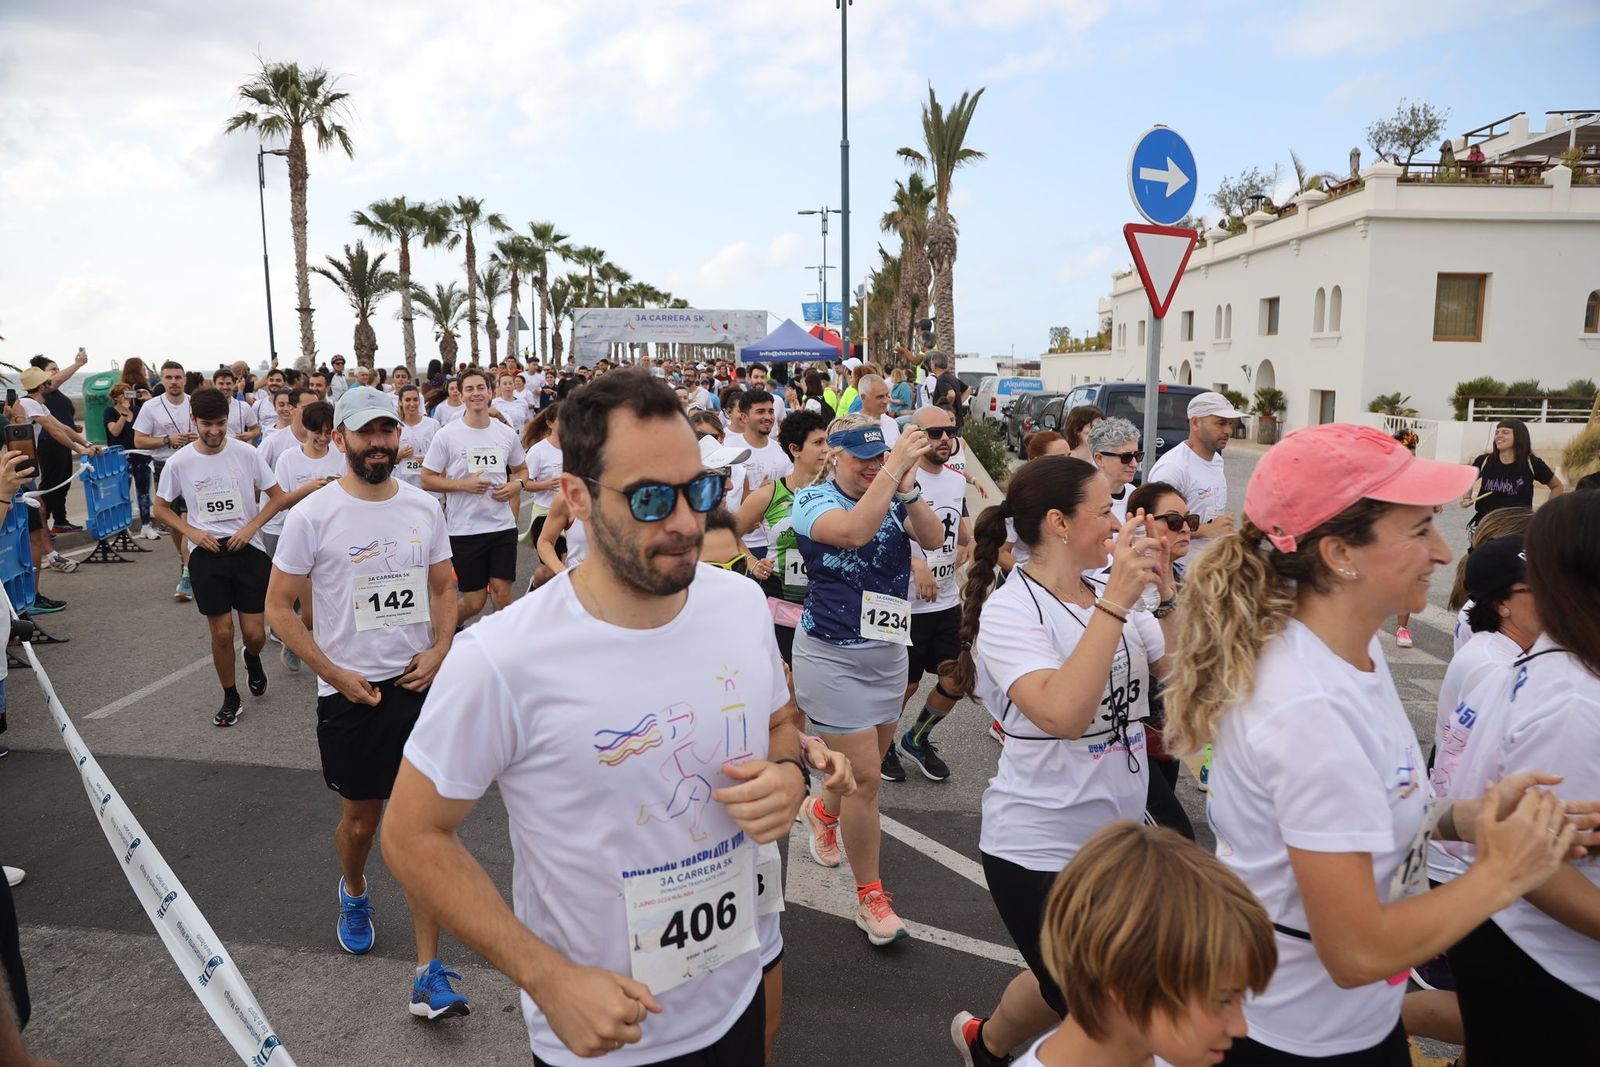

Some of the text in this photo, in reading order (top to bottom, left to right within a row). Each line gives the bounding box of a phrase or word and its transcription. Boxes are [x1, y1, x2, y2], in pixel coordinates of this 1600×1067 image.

[649, 314, 691, 322] CARRERA
[693, 314, 705, 322] 5K
[474, 455, 497, 465] 713
[206, 499, 234, 512] 595
[368, 588, 415, 612] 142
[866, 608, 908, 632] 1234
[660, 857, 733, 887] 3A CARRERA 5K
[659, 891, 737, 949] 406
